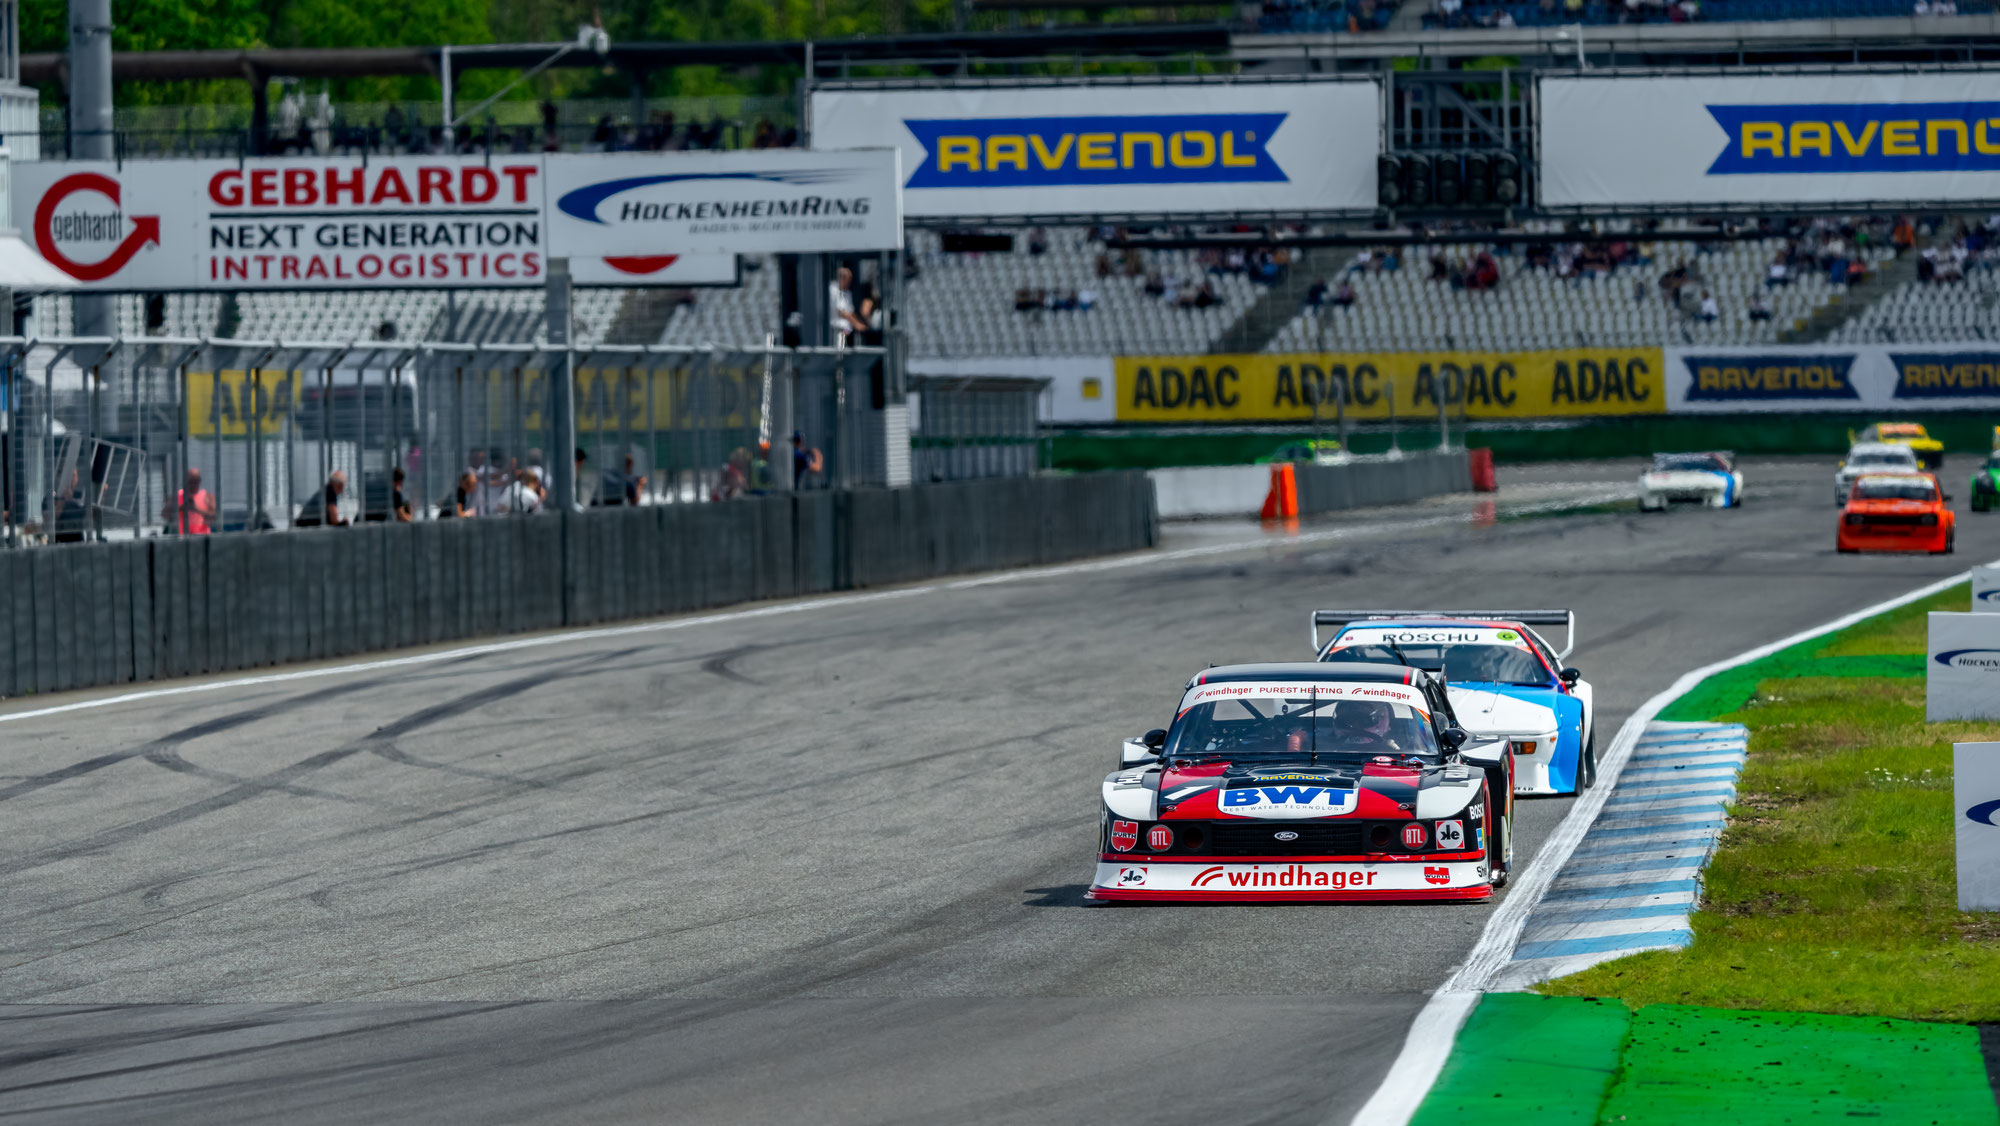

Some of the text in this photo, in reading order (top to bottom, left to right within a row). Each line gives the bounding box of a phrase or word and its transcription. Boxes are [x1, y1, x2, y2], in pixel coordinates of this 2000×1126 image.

[938, 130, 1257, 171] RAVENOL
[208, 166, 538, 206] GEBHARDT
[53, 210, 123, 242] gebhardt
[210, 222, 539, 248] NEXT GENERATION
[210, 253, 541, 280] INTRALOGISTICS
[1133, 365, 1241, 408] ADAC
[1274, 362, 1381, 407] ADAC
[1413, 362, 1516, 407] ADAC
[1552, 357, 1650, 403] ADAC
[1699, 365, 1843, 390] RAVENOL
[1382, 631, 1479, 642] RÖSCHU
[1205, 686, 1253, 697] windhager
[1300, 687, 1343, 695] HEATING
[1363, 688, 1411, 700] windhager
[1223, 786, 1354, 807] BWT
[1285, 804, 1345, 812] TECHNOLOGY
[1151, 830, 1168, 846] RTL
[1406, 828, 1423, 844] RTL
[1227, 864, 1378, 889] windhager
